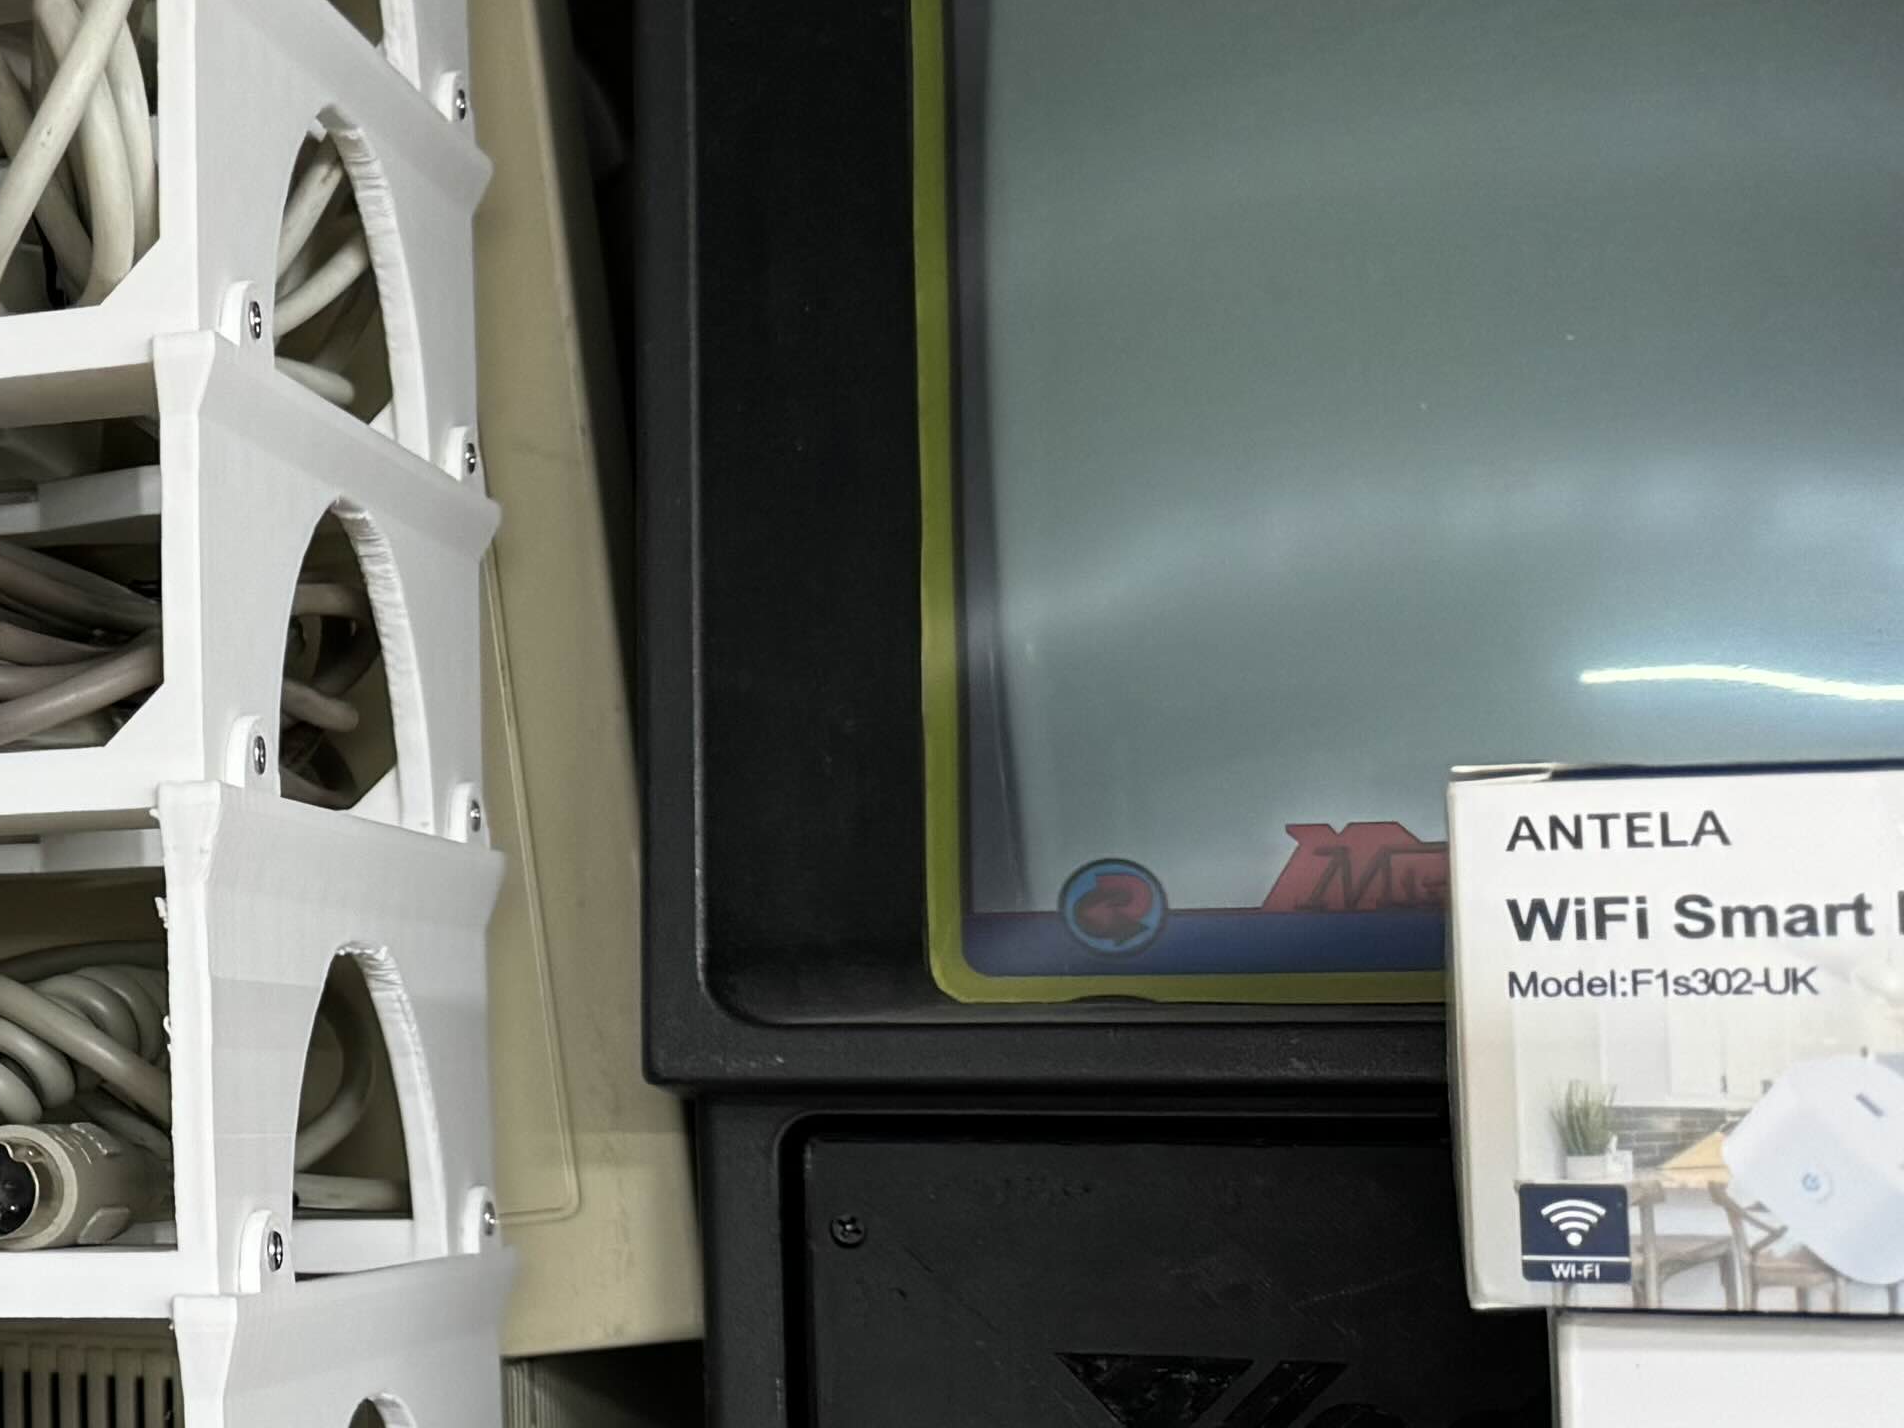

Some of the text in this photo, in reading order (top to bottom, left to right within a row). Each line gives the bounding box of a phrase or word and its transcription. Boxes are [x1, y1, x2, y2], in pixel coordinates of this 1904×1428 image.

[1505, 810, 1732, 853] ANTELA
[1506, 891, 1875, 943] WiFi Smart
[1507, 967, 1820, 999] Model:F1s302-UK
[1551, 1263, 1602, 1280] WI-FI
